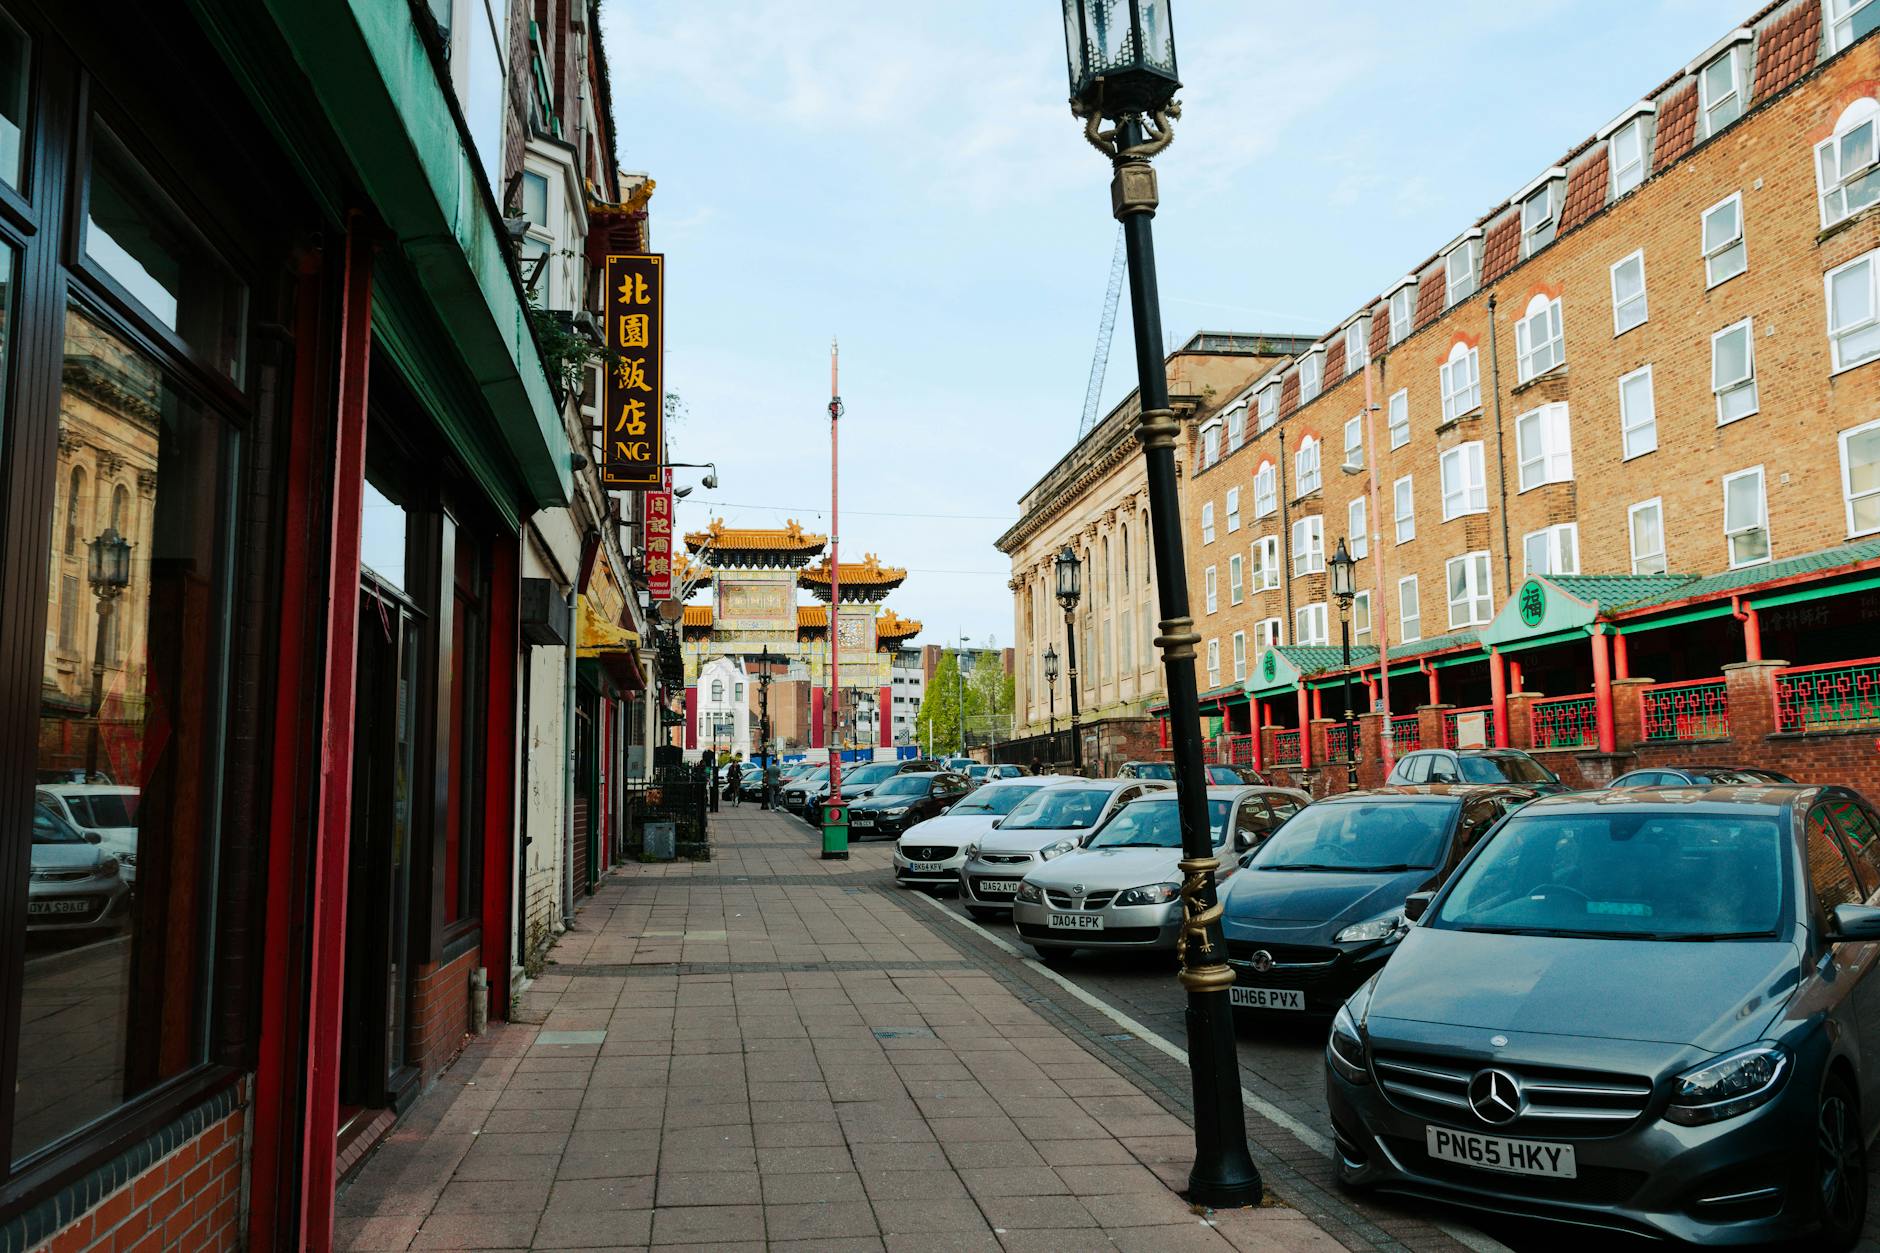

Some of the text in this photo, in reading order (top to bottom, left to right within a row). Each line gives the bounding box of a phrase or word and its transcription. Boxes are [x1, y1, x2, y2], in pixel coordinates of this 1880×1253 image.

[613, 272, 652, 436] 北園飯店
[615, 441, 651, 461] NG
[1522, 589, 1541, 618] 福
[983, 882, 1018, 892] DA62 AYD
[1052, 915, 1099, 928] DA04 EPK
[1232, 988, 1298, 1008] DH66 PVX
[1436, 1131, 1562, 1172] PN65 HKY
